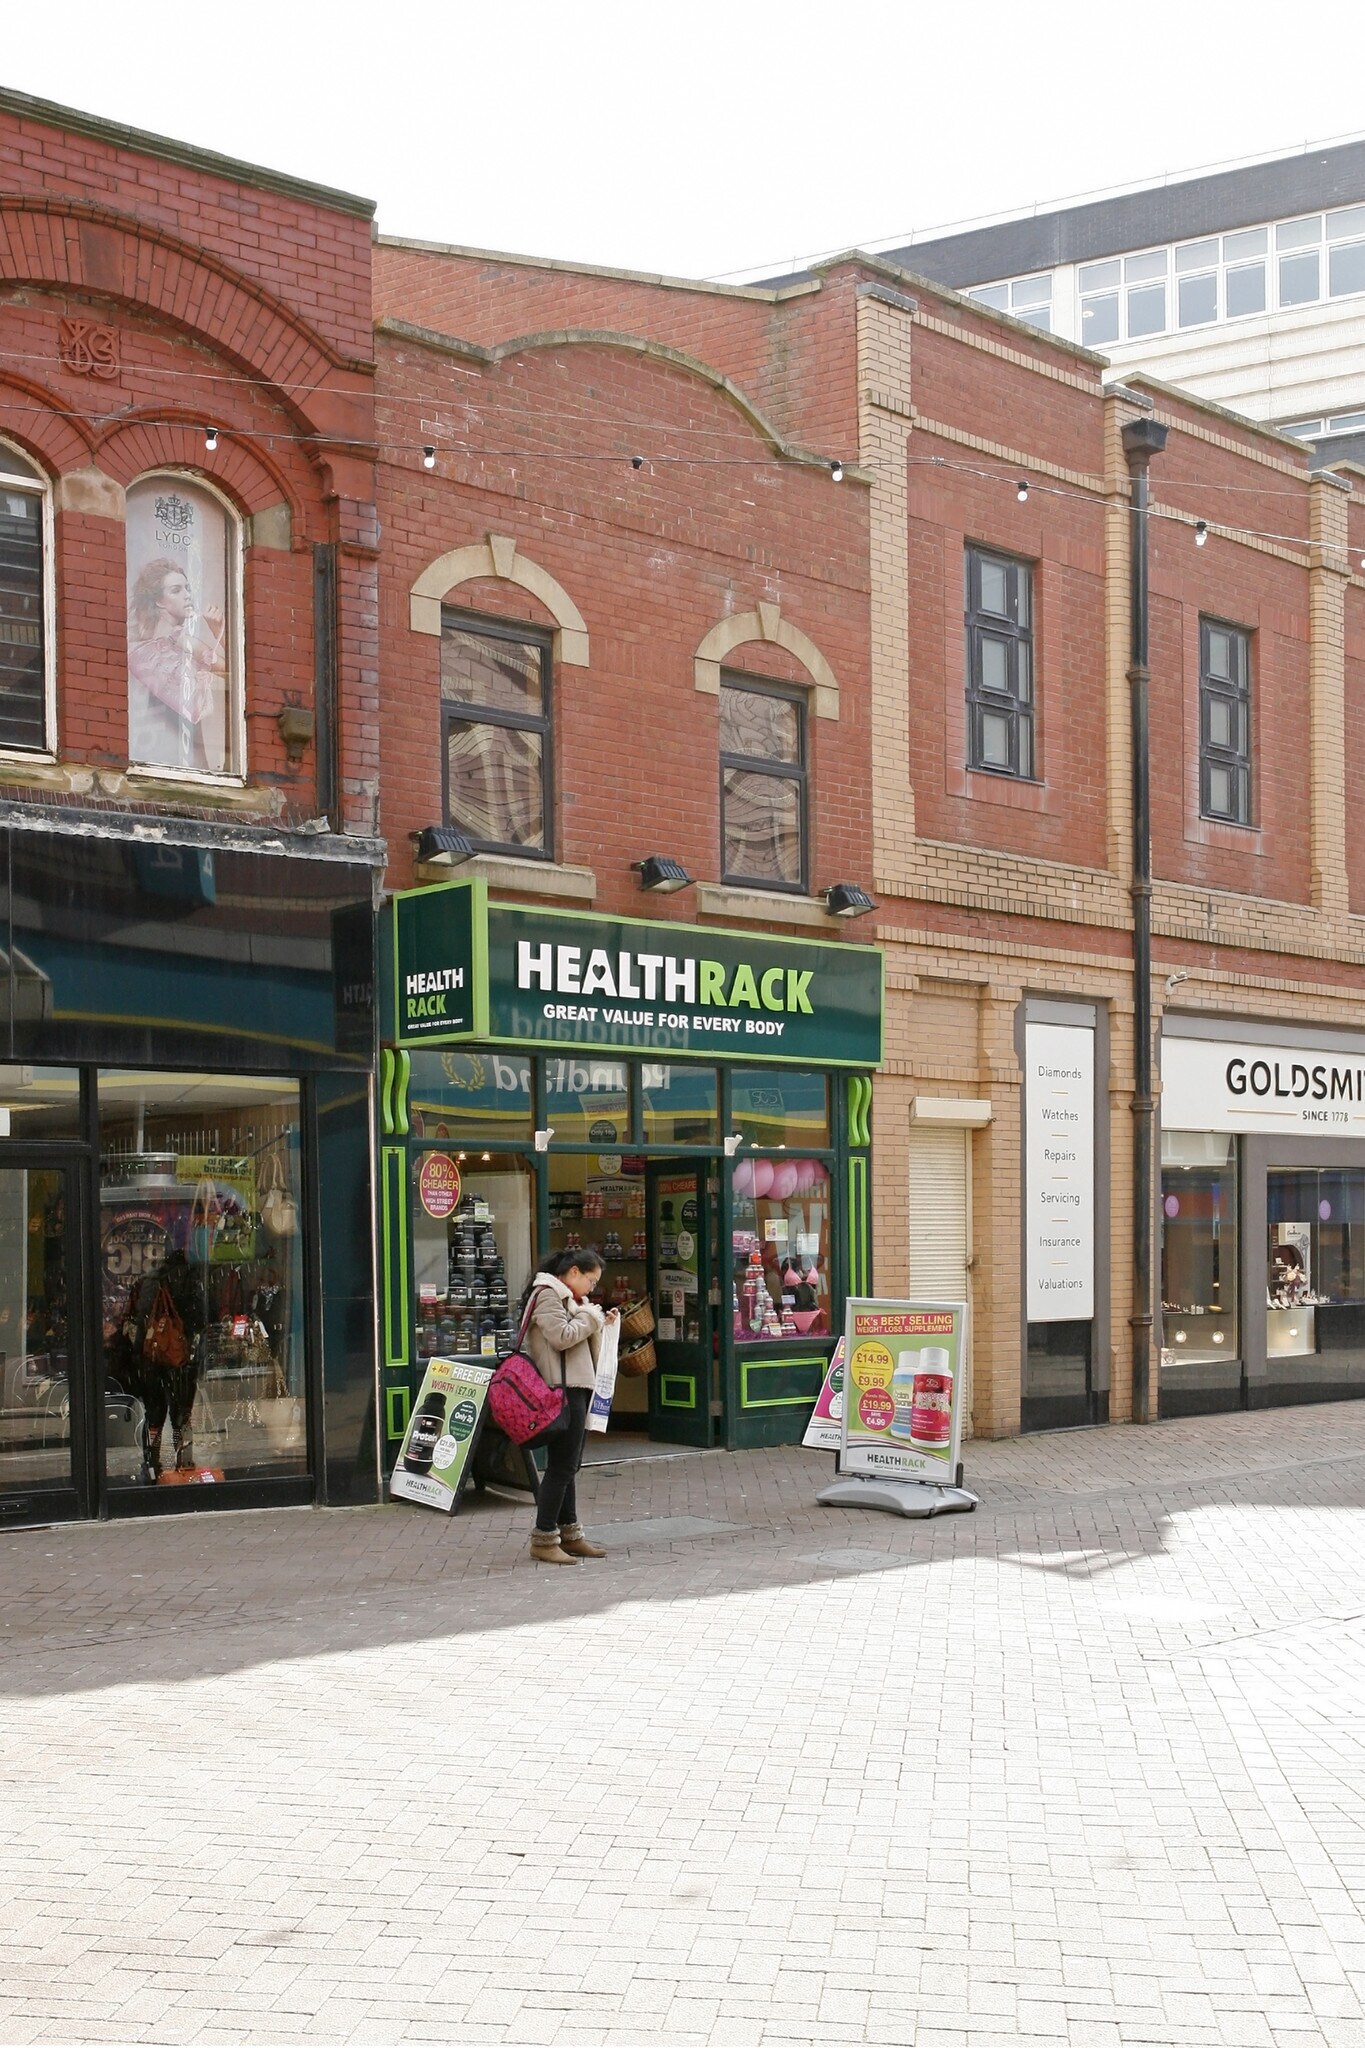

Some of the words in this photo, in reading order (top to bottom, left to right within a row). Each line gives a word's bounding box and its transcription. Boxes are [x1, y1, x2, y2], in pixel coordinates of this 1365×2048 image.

[155, 530, 191, 546] LYDC
[406, 967, 464, 995] HEALTH
[517, 940, 814, 1014] HEALTHRACK
[407, 994, 447, 1018] RACK
[543, 1003, 598, 1022] GREAT
[602, 1009, 654, 1026] VALUE
[658, 1013, 689, 1030] FOR
[693, 1016, 742, 1032] EVERY
[745, 1020, 785, 1036] BODY
[1038, 1065, 1082, 1080] Diamonds
[1226, 1058, 1365, 1102] GOLDSMI
[1041, 1108, 1079, 1121] Watches
[1302, 1110, 1329, 1121] SINCE
[1331, 1111, 1349, 1122] 1778
[1044, 1149, 1076, 1164] Repairs
[429, 1163, 454, 1179] 80%
[422, 1178, 459, 1190] CHEAPER
[1040, 1192, 1081, 1206] Servicing
[1039, 1236, 1081, 1247] Insurance
[1038, 1278, 1083, 1290] Valuations
[857, 1317, 878, 1326] UK's
[880, 1316, 907, 1326] BEST
[909, 1315, 952, 1325] SELLING
[857, 1325, 882, 1333] WEIGHT
[884, 1325, 903, 1333] LOSS
[904, 1324, 953, 1333] SUPPLEMENT
[857, 1352, 889, 1364] £14.99
[438, 1364, 450, 1376] Any
[452, 1367, 473, 1381] FREE
[858, 1376, 885, 1387] £9.99
[431, 1380, 455, 1393] WORTH
[456, 1384, 477, 1398] £7.00
[862, 1400, 892, 1411] £19.99
[454, 1411, 467, 1424] Only
[866, 1417, 886, 1426] £4.99
[412, 1430, 438, 1442] Protein
[867, 1453, 926, 1469] HEALTHRACK
